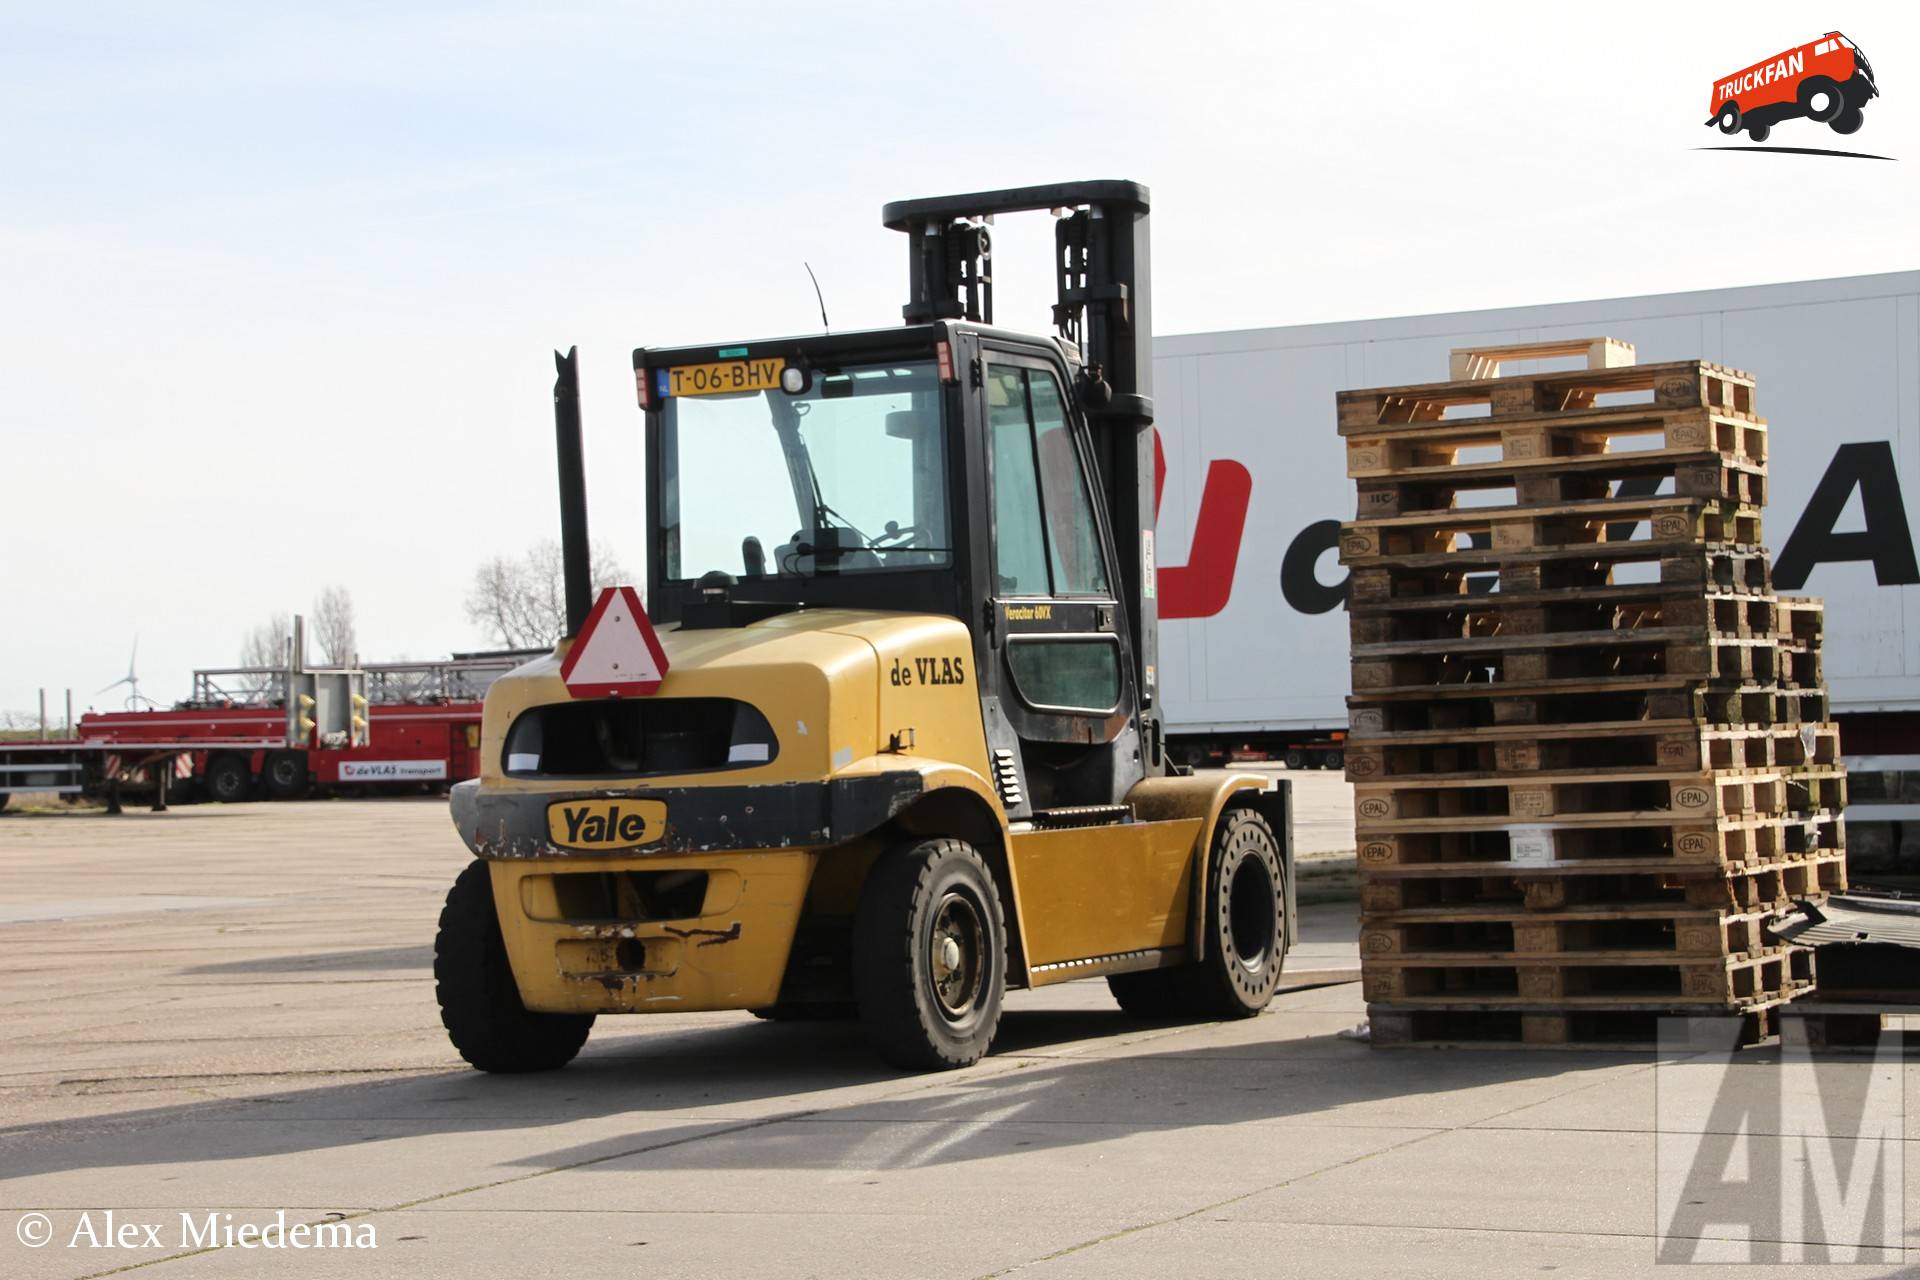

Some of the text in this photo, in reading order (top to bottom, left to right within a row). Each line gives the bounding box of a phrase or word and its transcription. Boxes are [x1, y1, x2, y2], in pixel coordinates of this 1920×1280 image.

[672, 362, 776, 392] T-06-BHV
[1661, 518, 1683, 531] EPAL
[891, 657, 964, 686] de VLAS
[371, 765, 397, 776] VLAS
[1681, 792, 1703, 804] EPAL
[1364, 802, 1385, 814] EPAL
[563, 806, 646, 843] Yale
[1683, 838, 1704, 850] EPAL
[1366, 846, 1386, 858] EPAL
